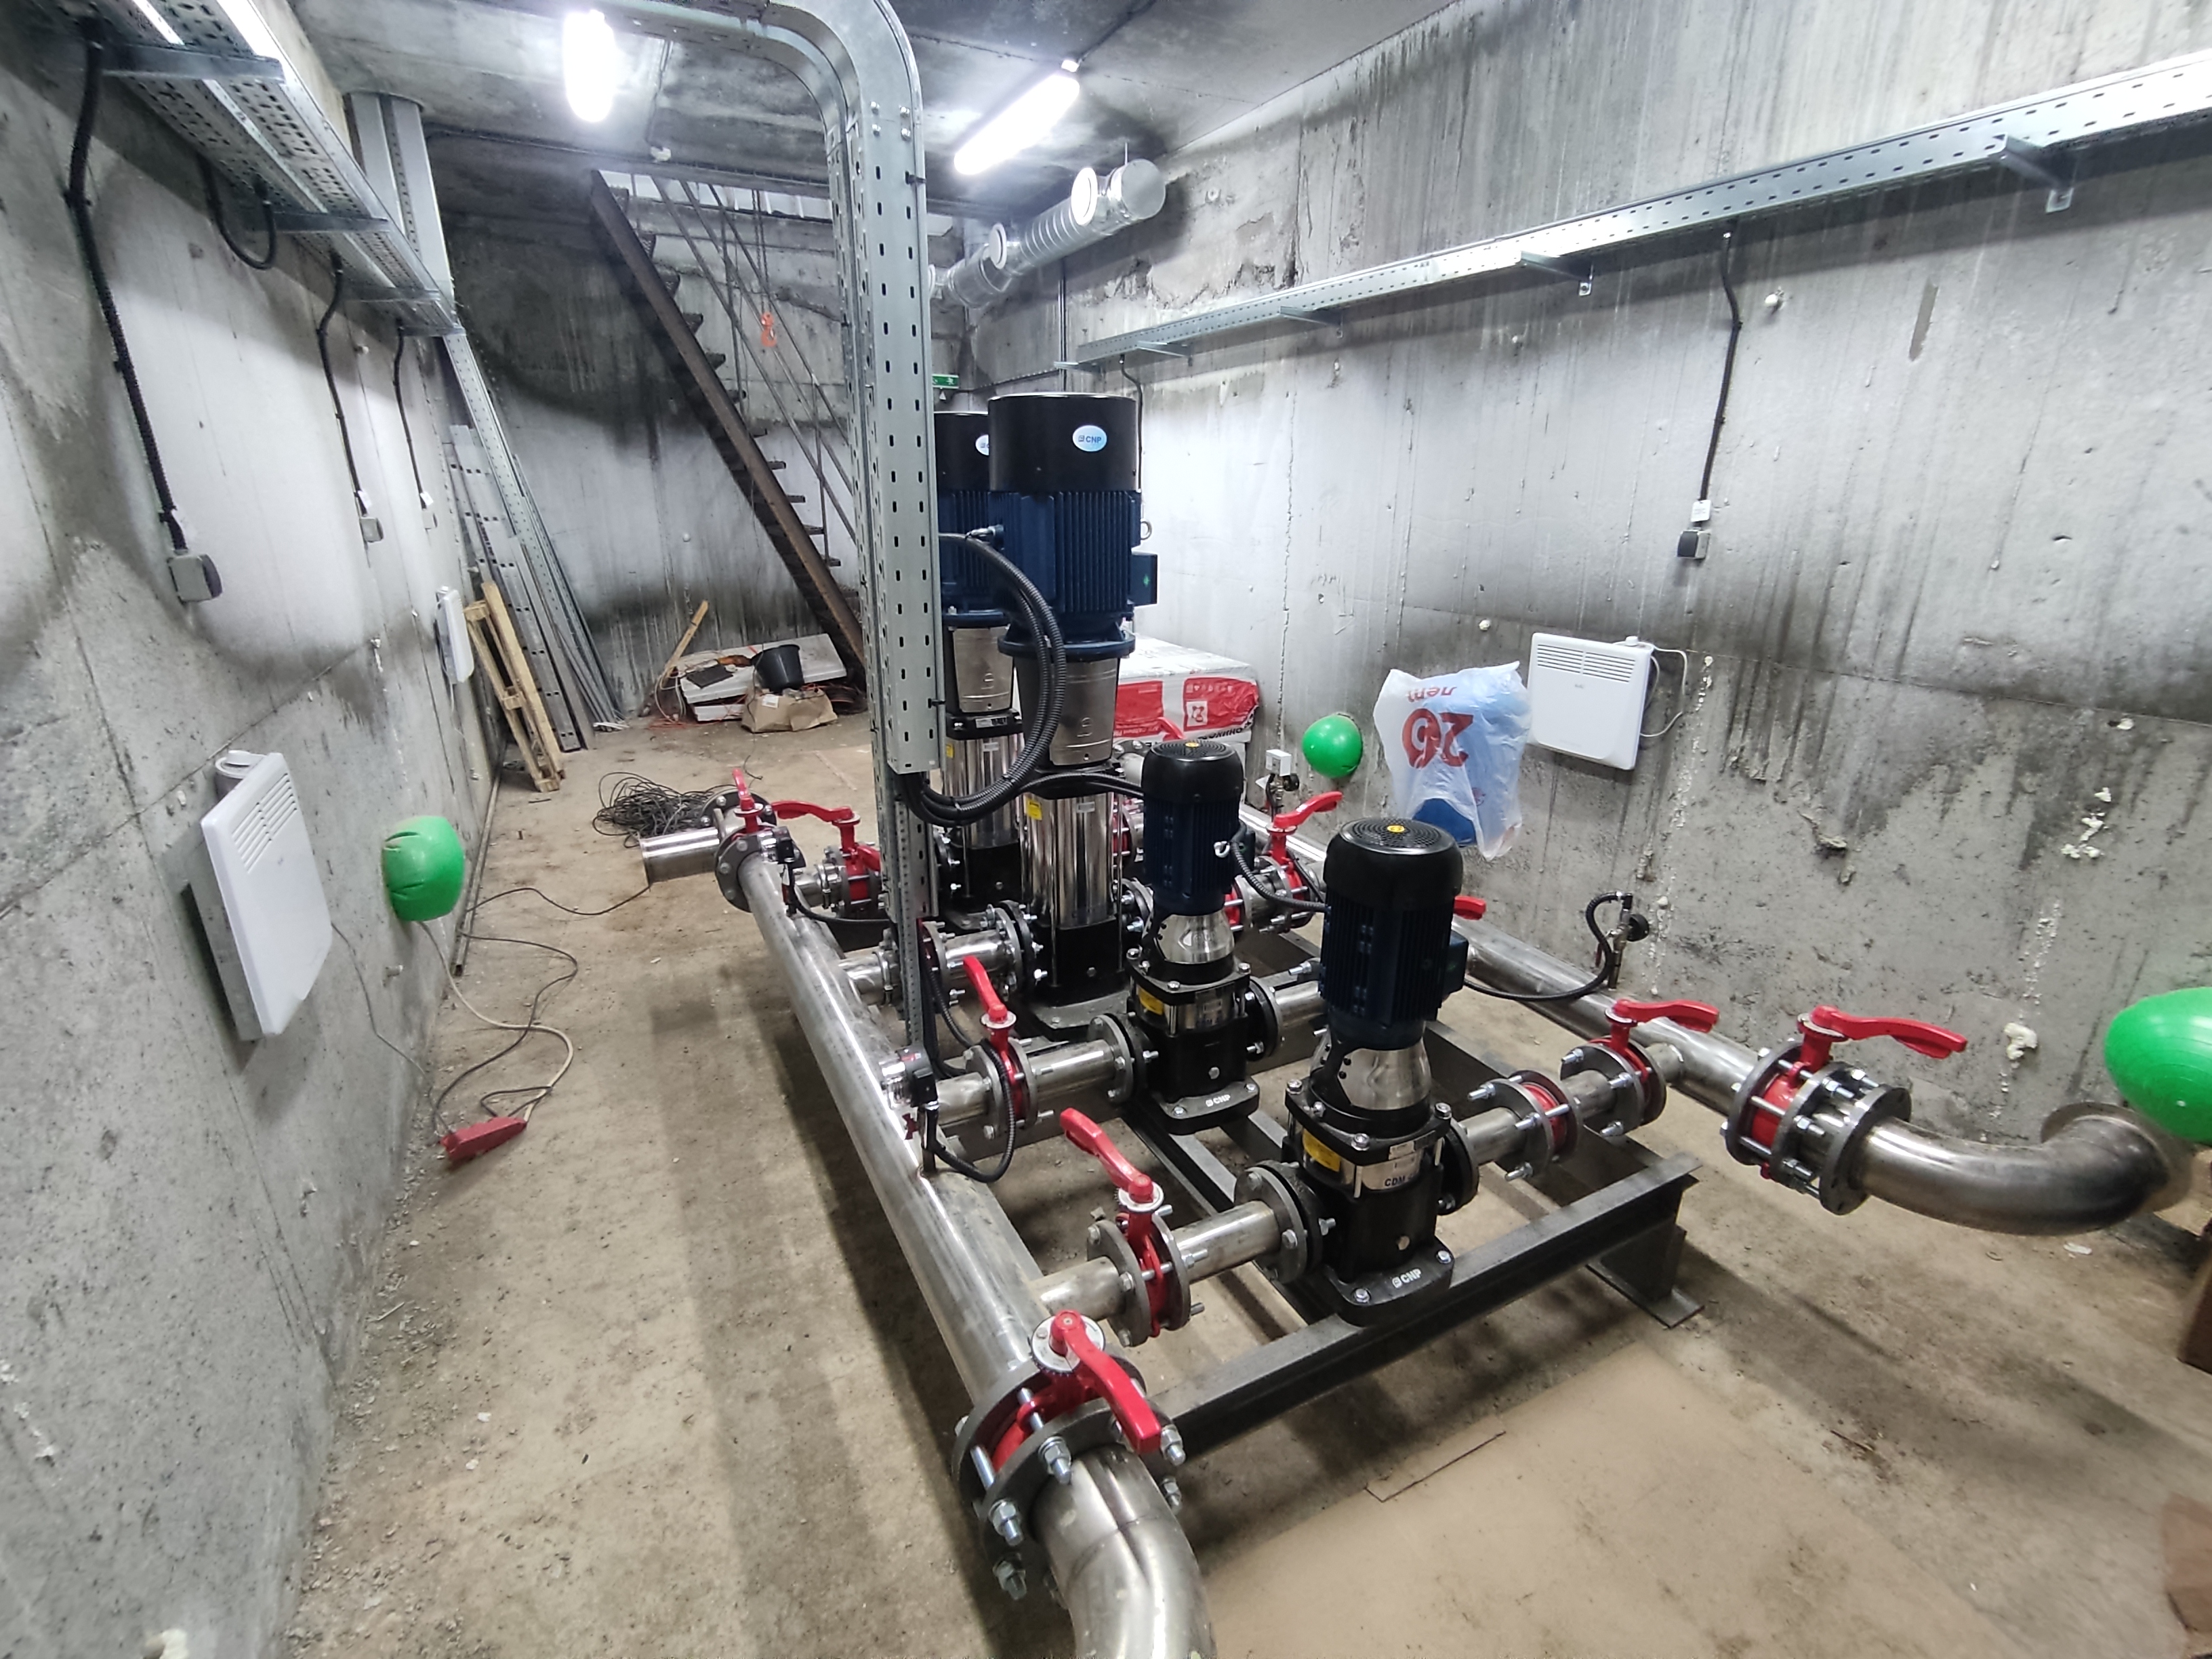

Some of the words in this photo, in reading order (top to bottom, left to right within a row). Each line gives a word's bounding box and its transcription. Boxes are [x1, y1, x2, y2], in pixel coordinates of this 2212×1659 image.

[1086, 436, 1102, 444] CNP
[1213, 1094, 1231, 1104] CNP
[1400, 1268, 1422, 1284] CNP
